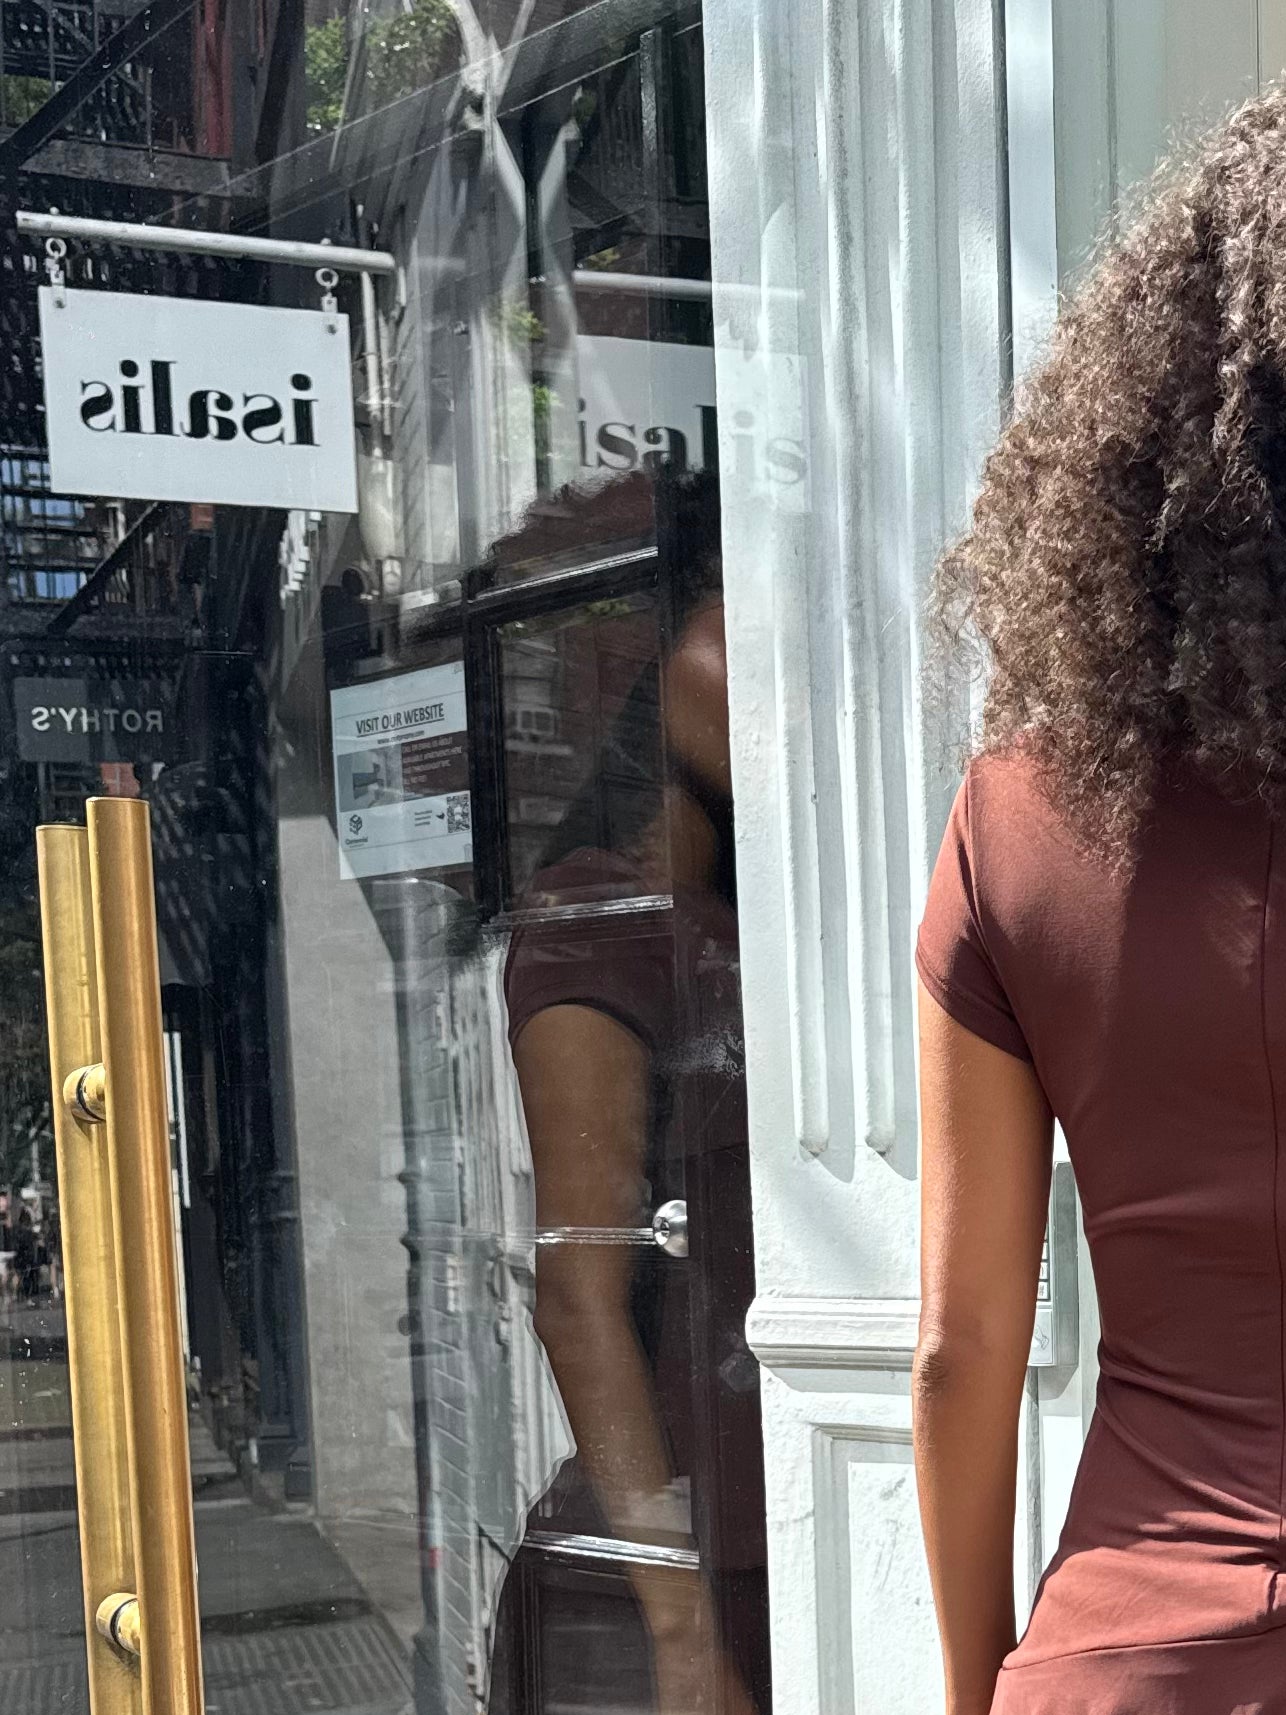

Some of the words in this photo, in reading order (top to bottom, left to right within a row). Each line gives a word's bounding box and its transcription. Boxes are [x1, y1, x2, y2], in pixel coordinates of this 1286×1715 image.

[356, 717, 379, 734] VISIT
[382, 712, 402, 729] OUR
[404, 703, 444, 725] WEBSITE
